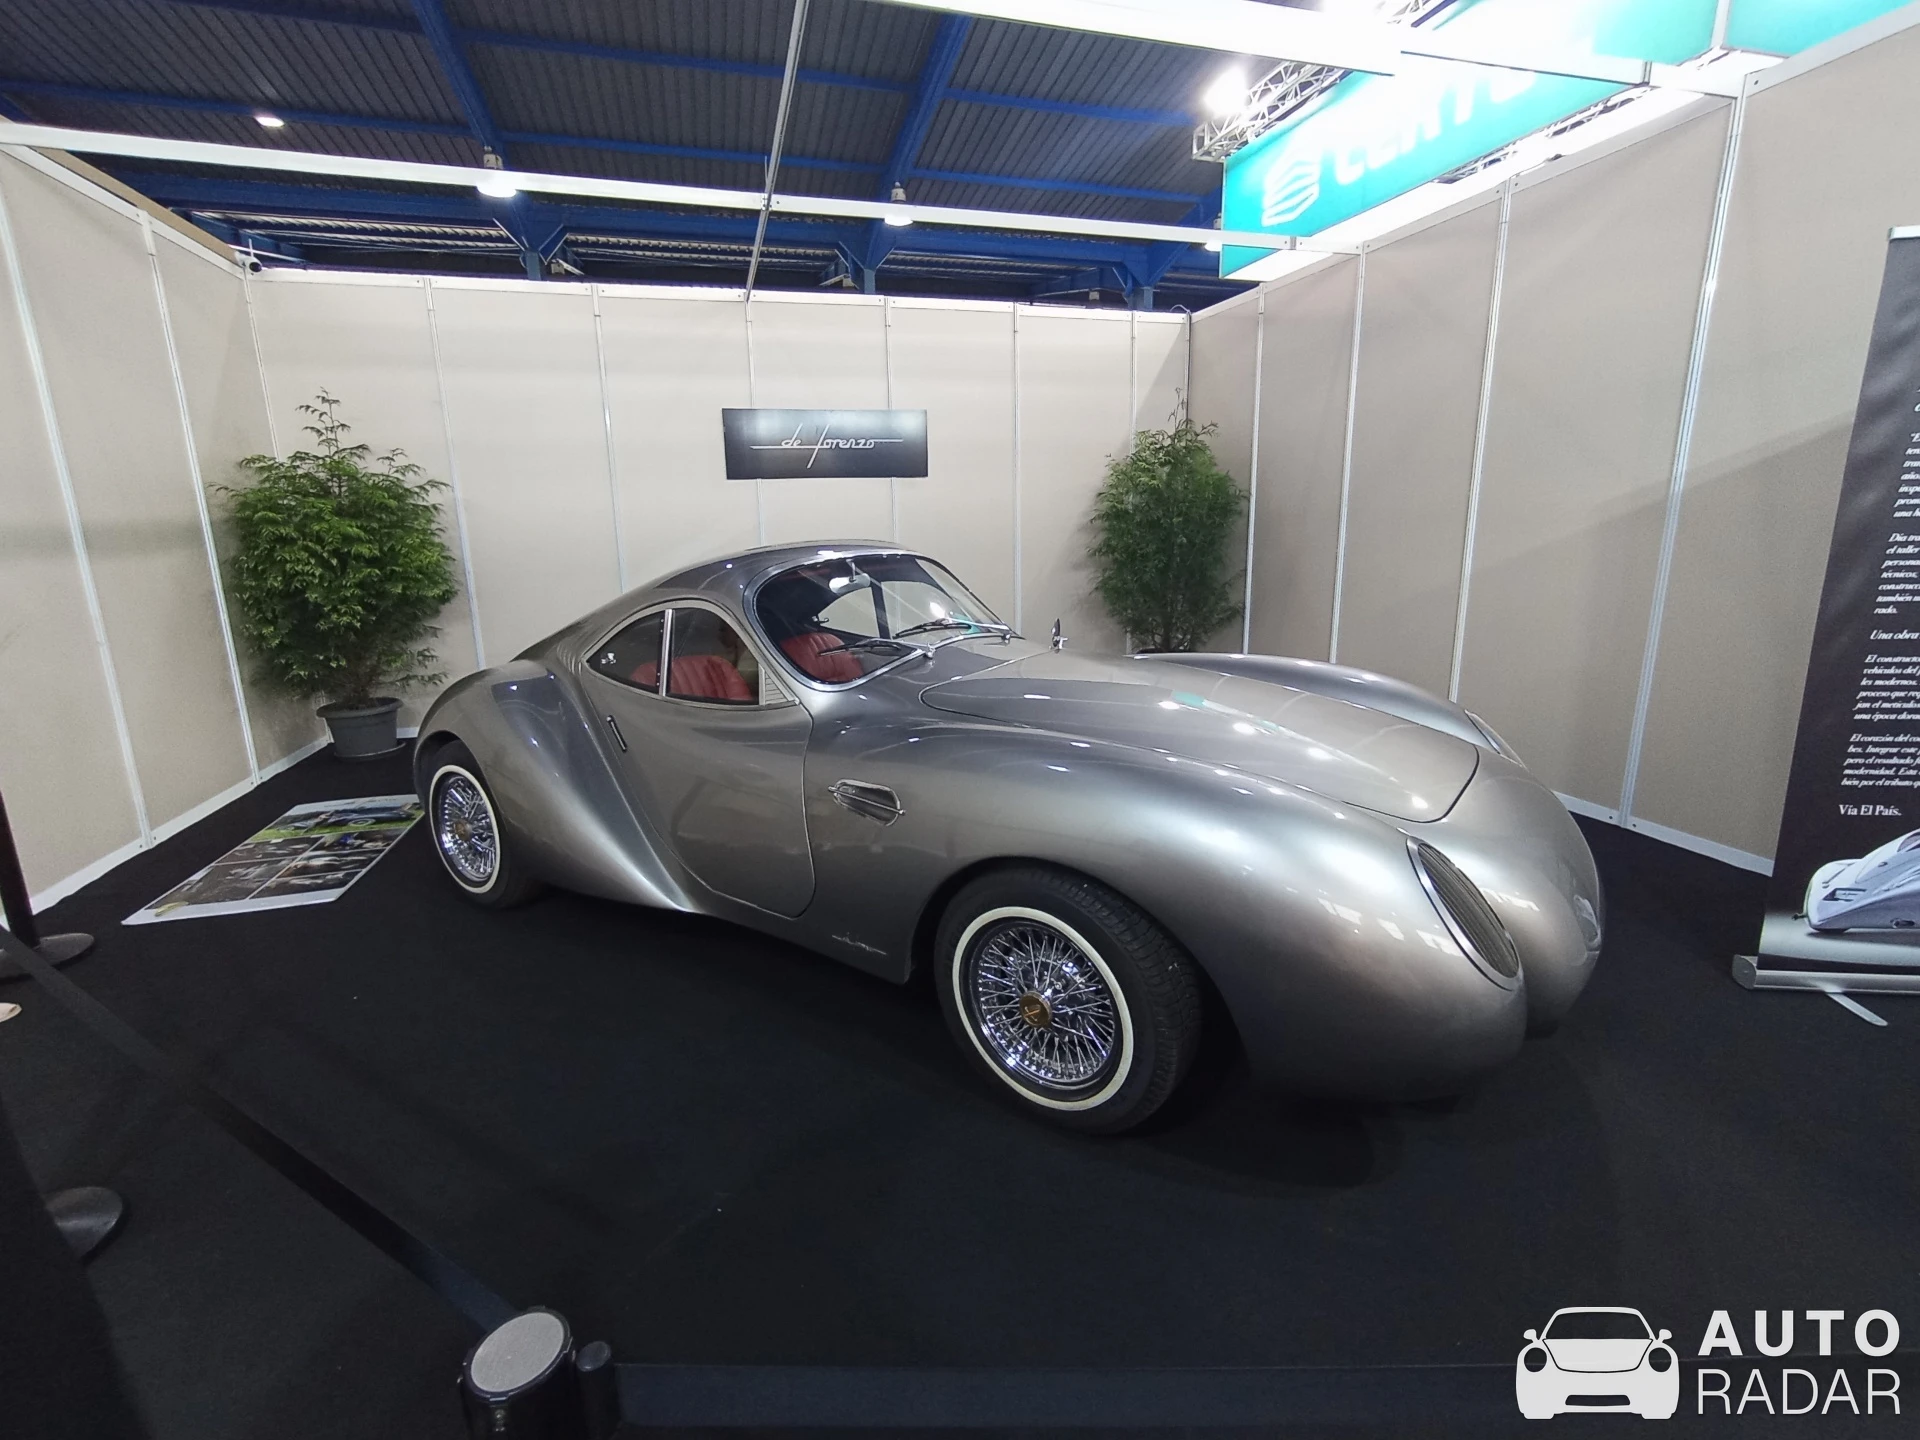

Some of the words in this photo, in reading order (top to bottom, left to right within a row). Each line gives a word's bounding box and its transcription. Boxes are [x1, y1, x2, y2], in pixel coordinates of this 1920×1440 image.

[1885, 544, 1898, 554] el
[1876, 593, 1913, 602] también
[1870, 629, 1894, 640] Una
[1893, 629, 1919, 640] obra
[1864, 654, 1878, 663] El
[1902, 665, 1919, 674] del
[1890, 691, 1909, 700] que
[1871, 700, 1882, 708] el
[1849, 733, 1862, 742] El
[1843, 758, 1865, 766] pero
[1865, 755, 1876, 764] el
[1857, 780, 1876, 788] por
[1875, 777, 1886, 786] el
[1839, 804, 1858, 815] Vía
[1860, 804, 1873, 815] El
[1874, 804, 1902, 816] País.
